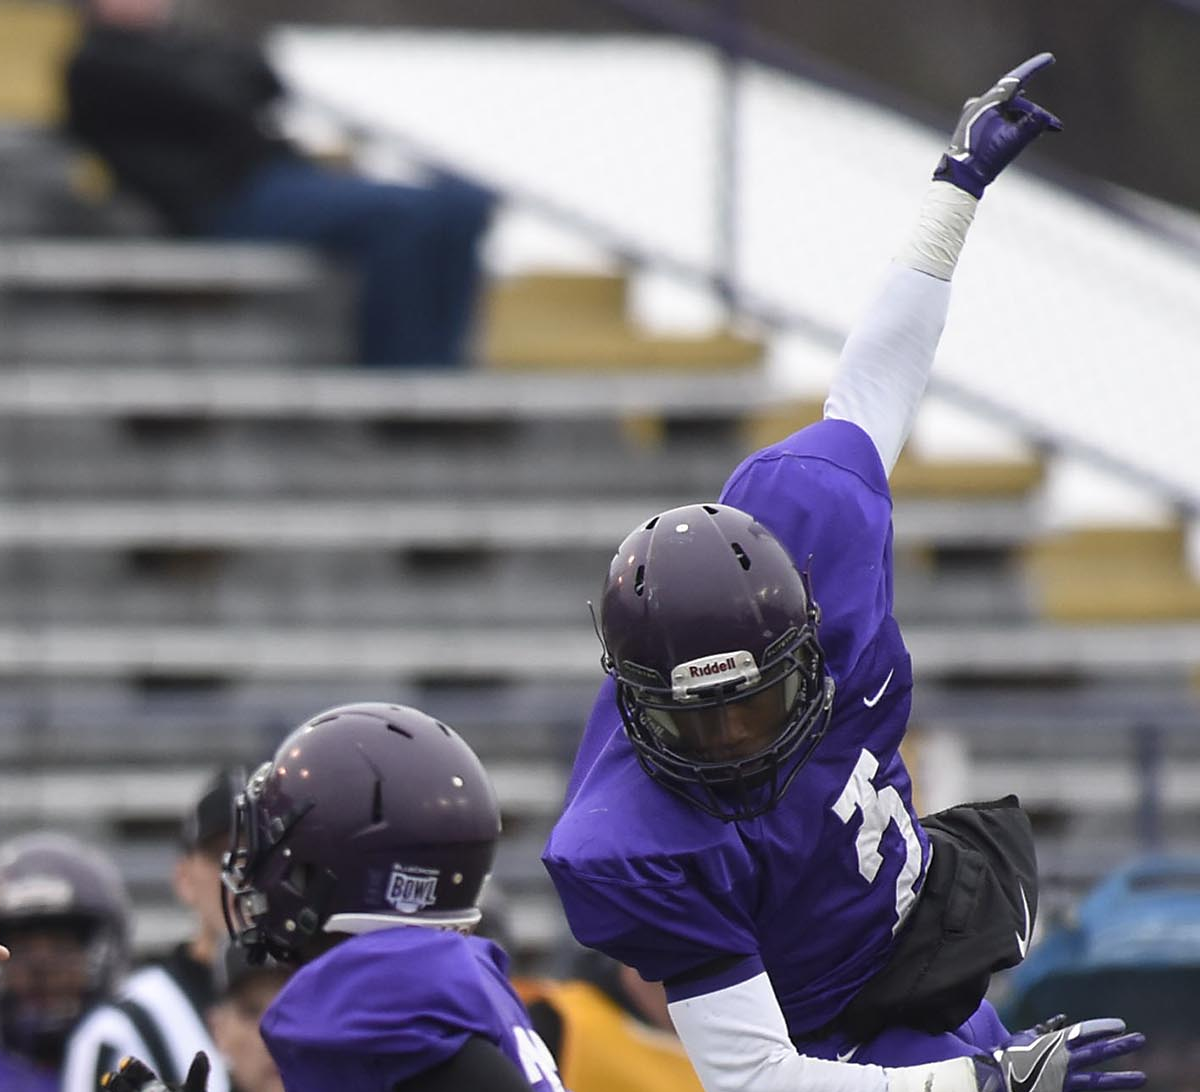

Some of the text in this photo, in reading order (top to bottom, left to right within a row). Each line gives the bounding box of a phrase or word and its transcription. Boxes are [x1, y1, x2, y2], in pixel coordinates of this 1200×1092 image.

[688, 657, 737, 679] Riddell
[831, 747, 922, 925] 3
[390, 874, 437, 904] BOWL
